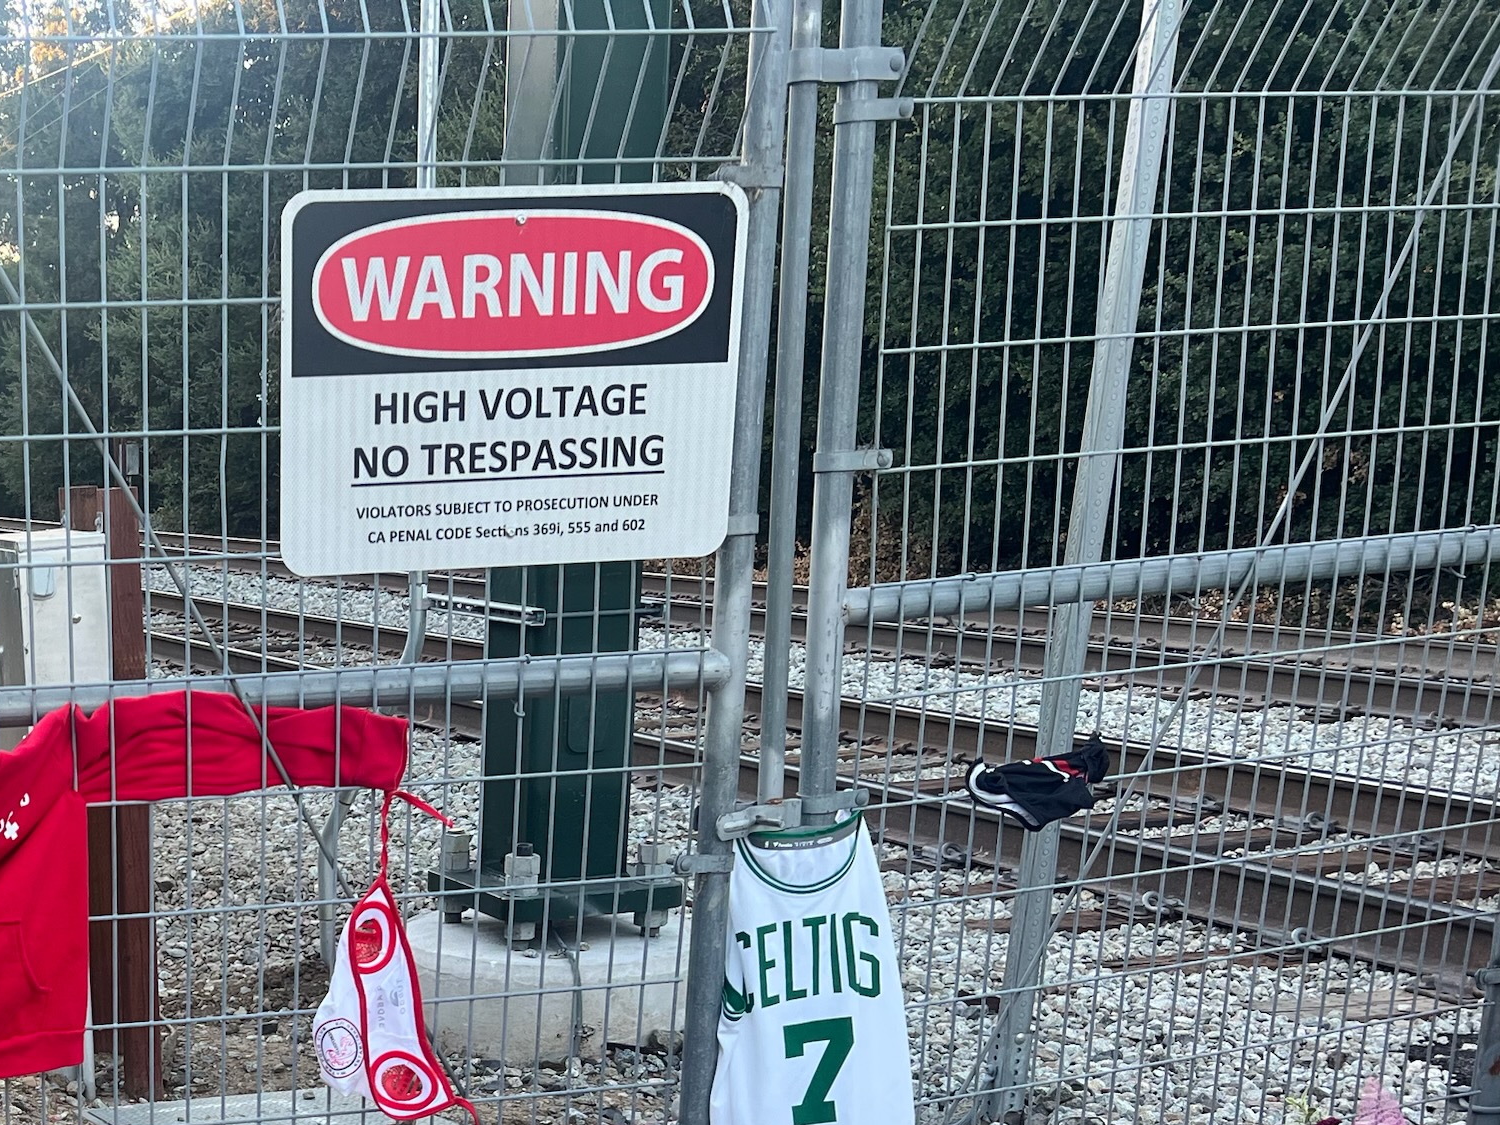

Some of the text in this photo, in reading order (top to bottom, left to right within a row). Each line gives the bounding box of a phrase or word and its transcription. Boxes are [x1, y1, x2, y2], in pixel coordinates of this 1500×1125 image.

[341, 248, 685, 322] WARNING
[374, 383, 648, 425] HIGH VOLTAGE
[353, 434, 665, 479] NO TRESPASSING
[356, 494, 659, 520] VIOLATORS SUBJECT TO PROSECUTION UNDER
[368, 518, 645, 544] CA PENAL CODE Sectins 369i, 555 and 602
